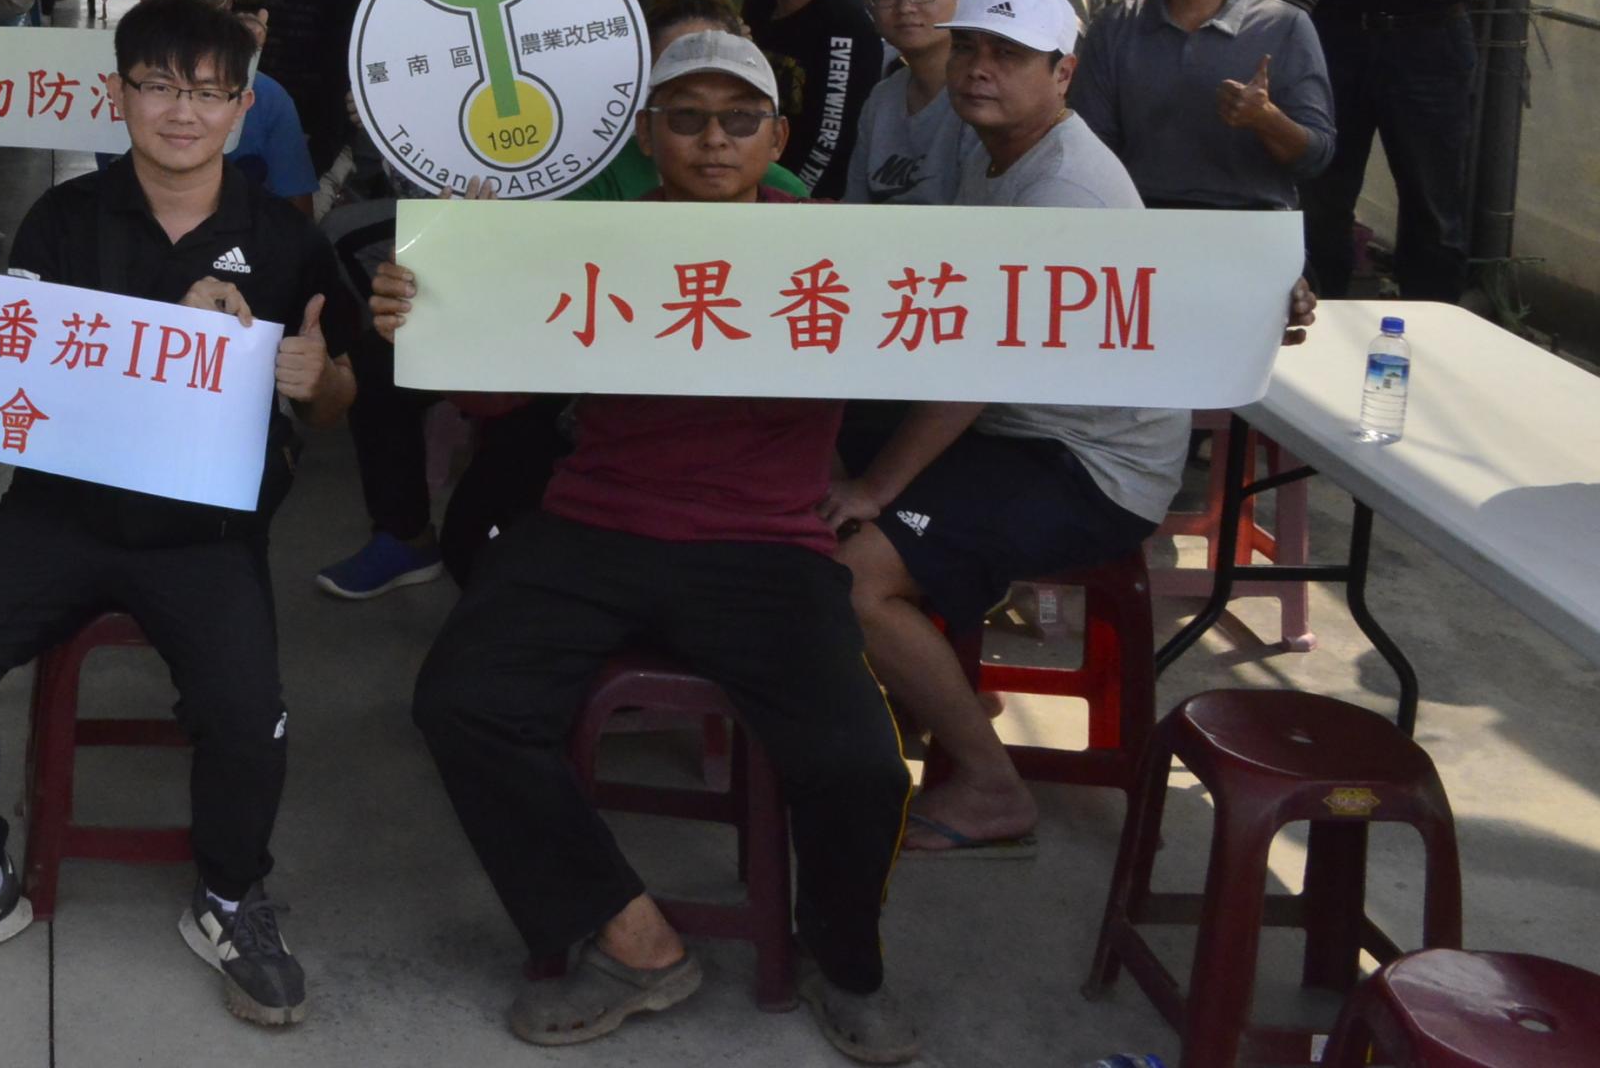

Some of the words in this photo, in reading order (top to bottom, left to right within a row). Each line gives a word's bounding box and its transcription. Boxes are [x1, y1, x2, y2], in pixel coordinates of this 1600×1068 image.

[366, 45, 474, 85] 臺南區
[520, 15, 630, 56] 農業改良場
[817, 36, 853, 151] EVERYWHERE
[390, 125, 467, 192] Tainan
[592, 80, 635, 143] MOA
[487, 124, 540, 152] 1902
[212, 260, 251, 274] adidas
[546, 259, 1157, 352] 小果番茄IPM
